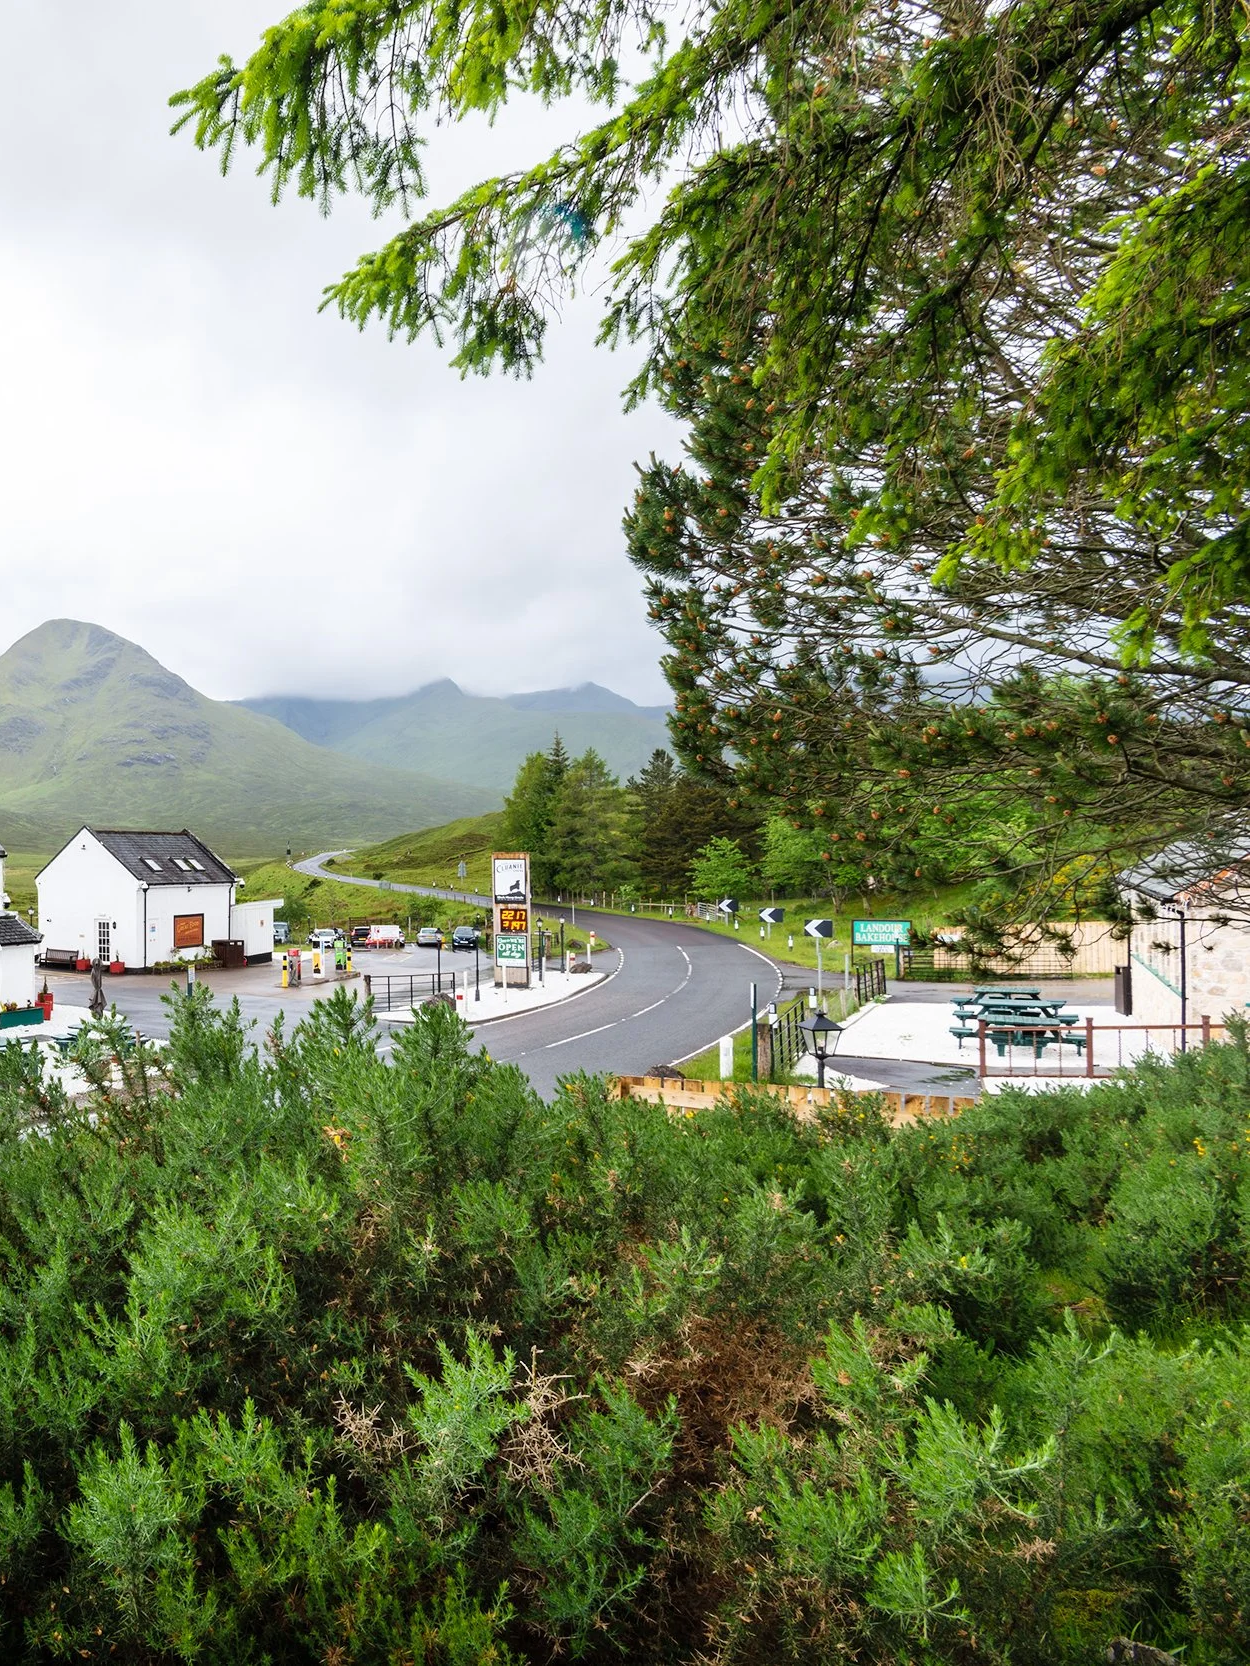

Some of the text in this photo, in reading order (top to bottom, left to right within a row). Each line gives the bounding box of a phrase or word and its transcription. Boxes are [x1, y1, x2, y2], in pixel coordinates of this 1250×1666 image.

[496, 863, 523, 873] CLUANIE
[860, 923, 903, 933] LANDOUR
[498, 943, 525, 951] OPEN
